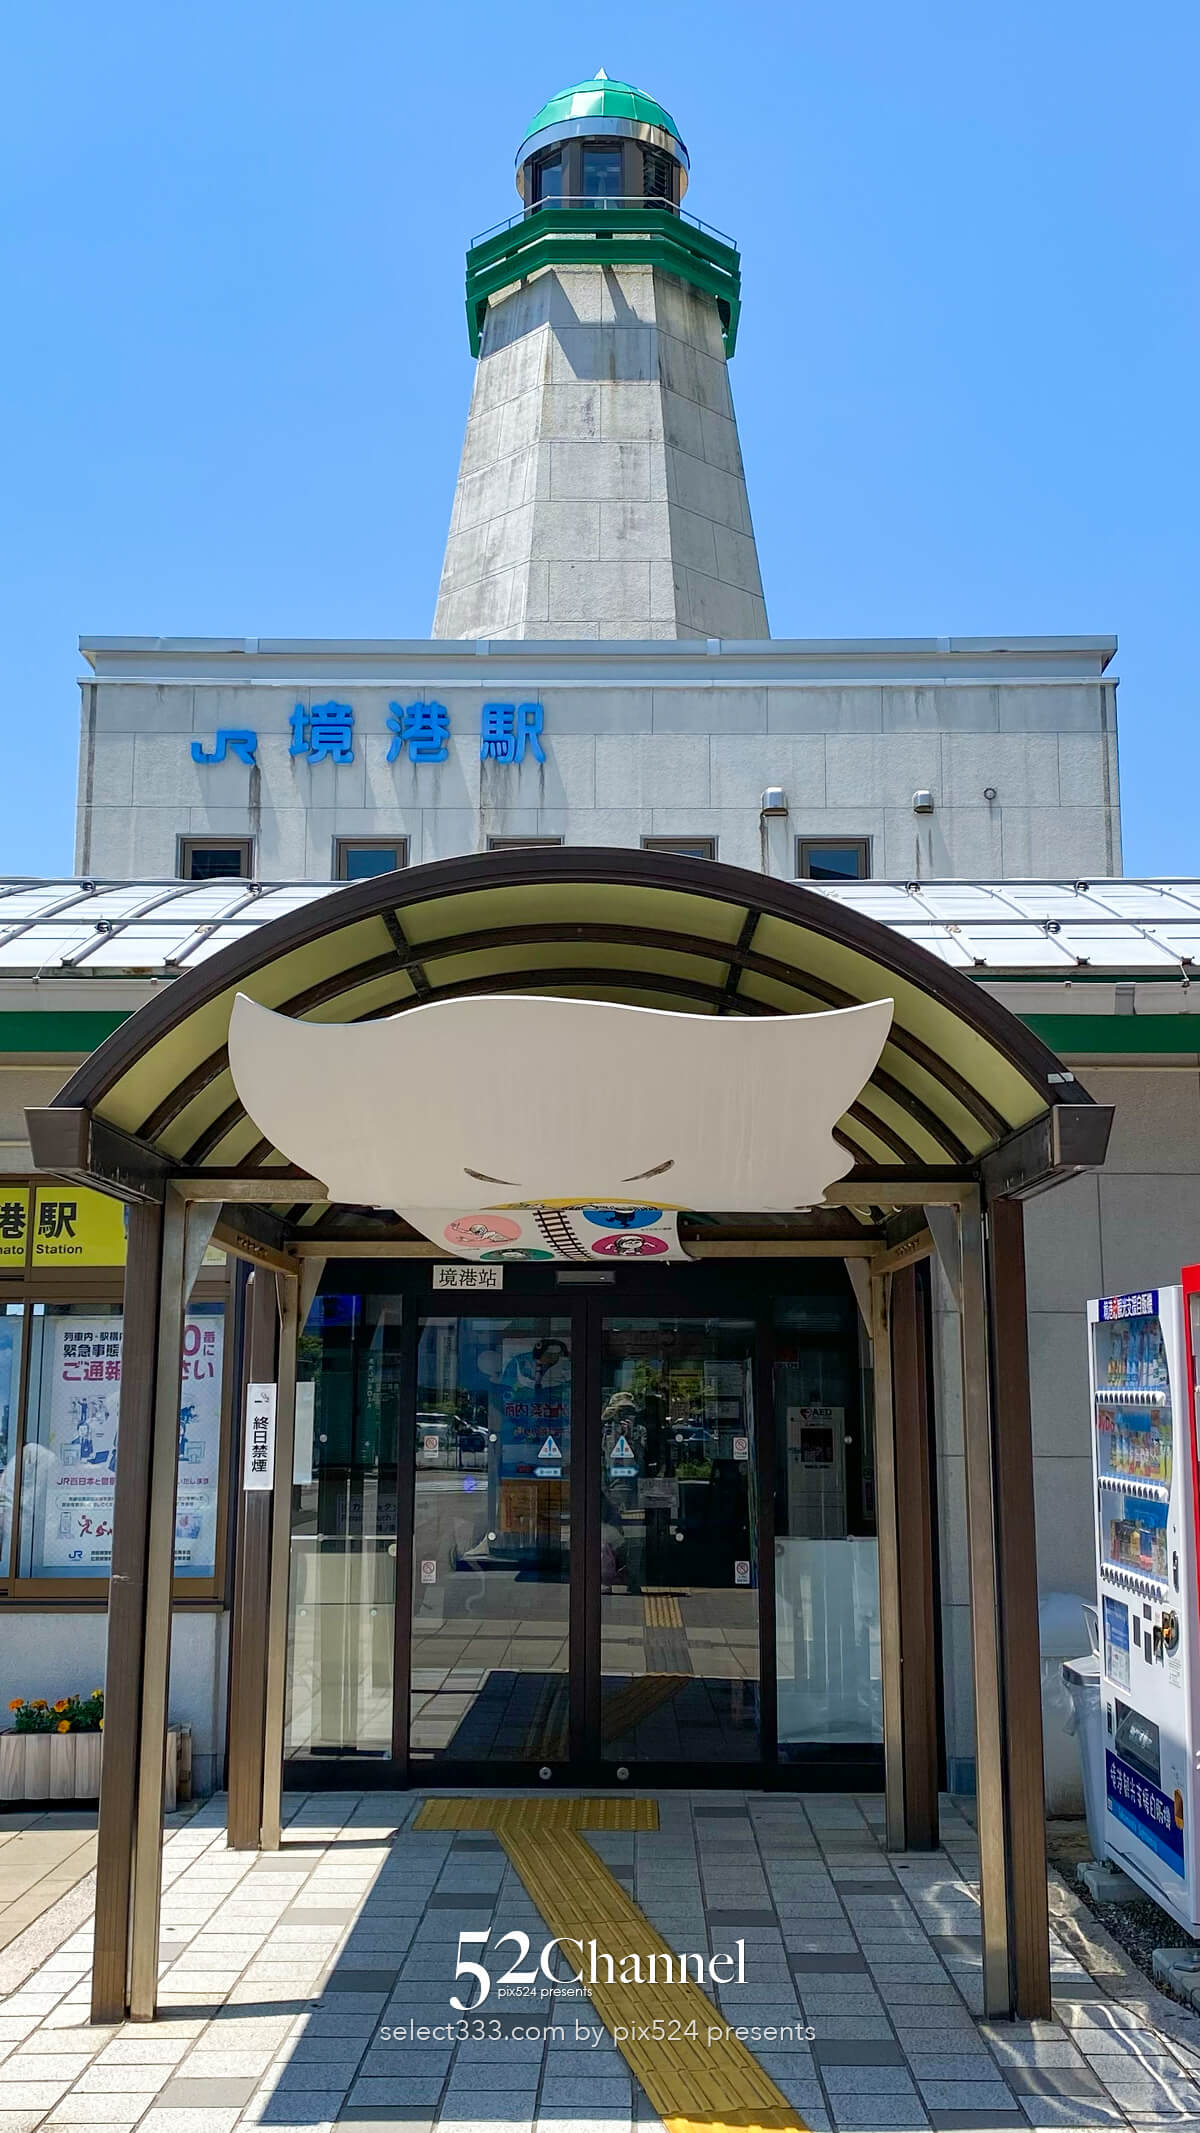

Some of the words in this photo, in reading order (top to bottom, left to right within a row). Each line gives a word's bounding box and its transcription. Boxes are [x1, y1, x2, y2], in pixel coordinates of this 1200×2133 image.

[191, 730, 257, 765] JR
[289, 701, 547, 765] 境港駅
[36, 1244, 82, 1255] Station
[439, 1268, 497, 1287] 境港站
[813, 1408, 832, 1416] AED
[251, 1416, 269, 1472] 終日禁煙
[68, 1550, 83, 1559] JR
